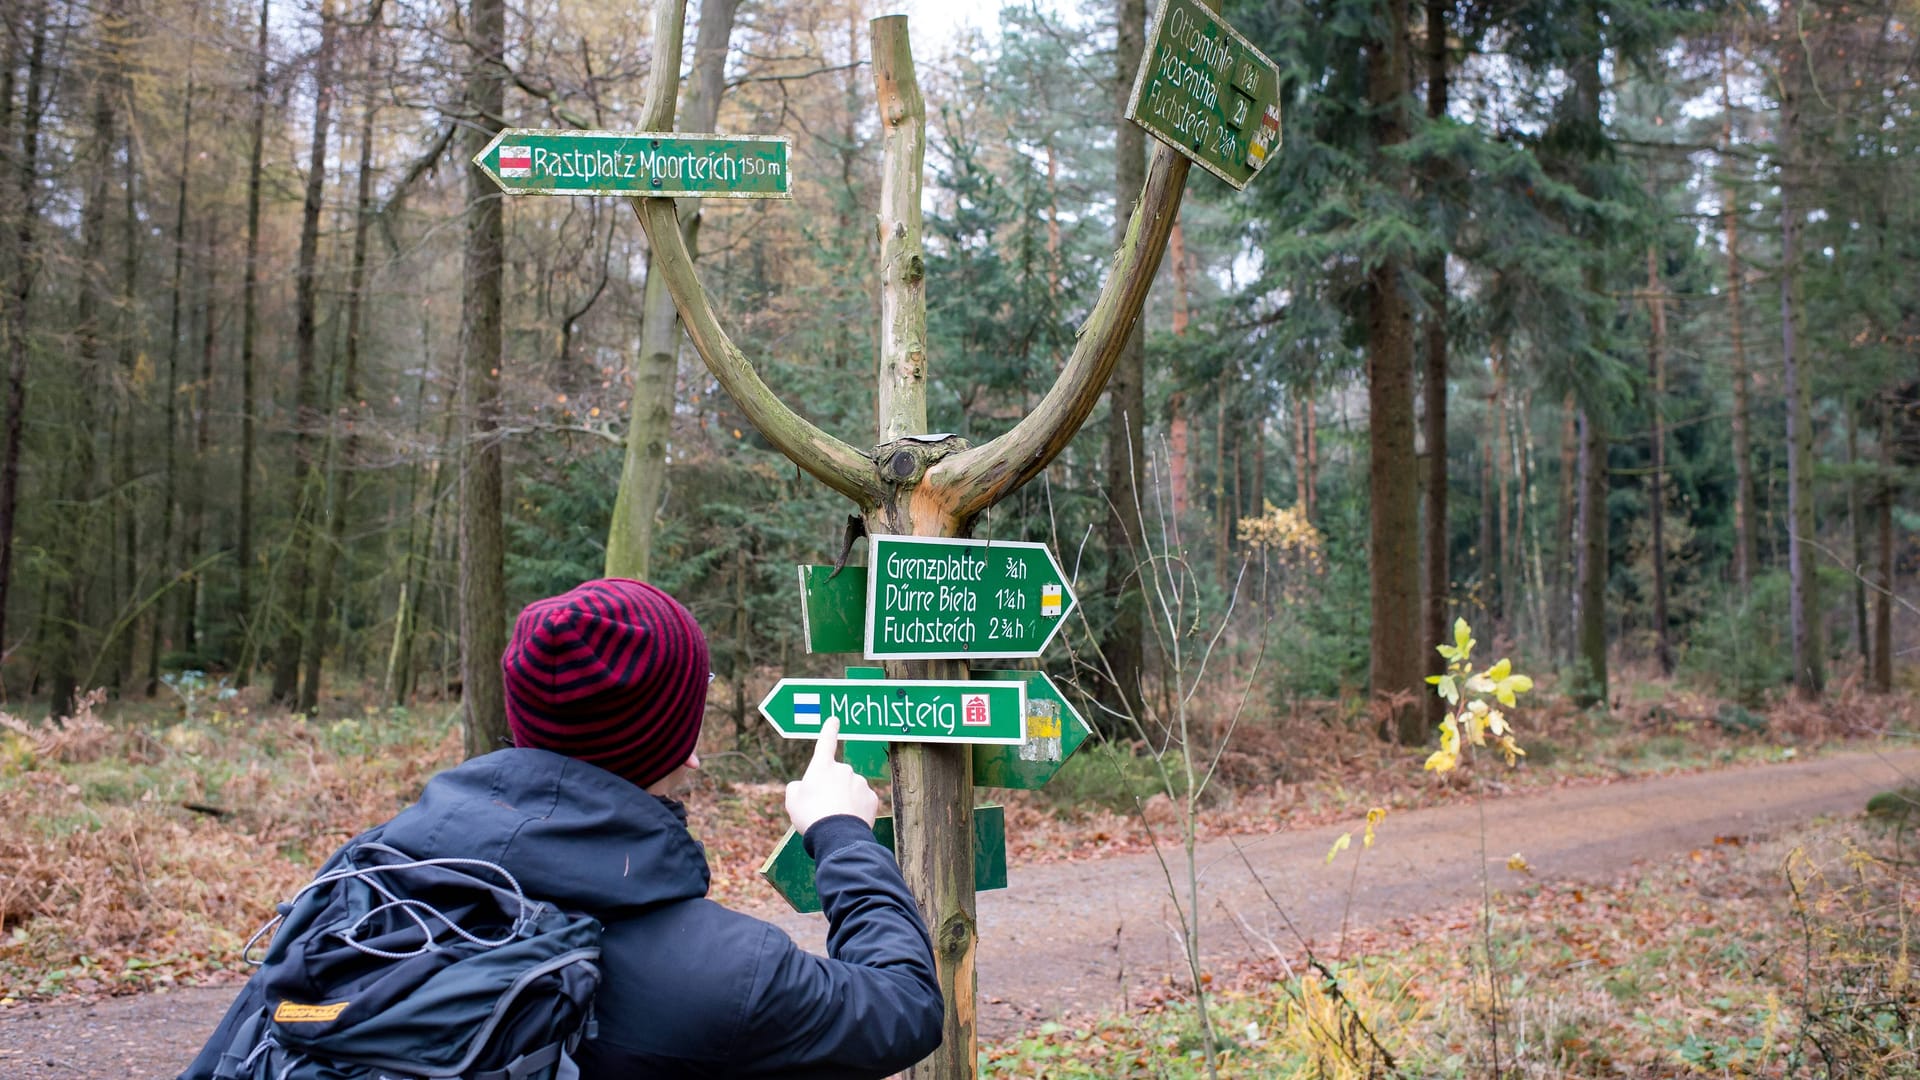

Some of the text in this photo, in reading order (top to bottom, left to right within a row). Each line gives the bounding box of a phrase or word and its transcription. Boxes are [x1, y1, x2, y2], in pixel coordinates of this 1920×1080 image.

[1170, 7, 1234, 74] Ottomühle
[1158, 44, 1221, 110] Rosenthal
[1147, 79, 1210, 145] Fuchsteich
[534, 147, 781, 182] Rastplatz Moorteich 150 m
[887, 551, 985, 584] Grenzplatte
[885, 583, 935, 612] Dürre
[939, 583, 977, 612] Biela
[884, 616, 976, 643] Fuchsteich
[830, 693, 955, 735] Mehlsteig
[966, 706, 987, 723] EB
